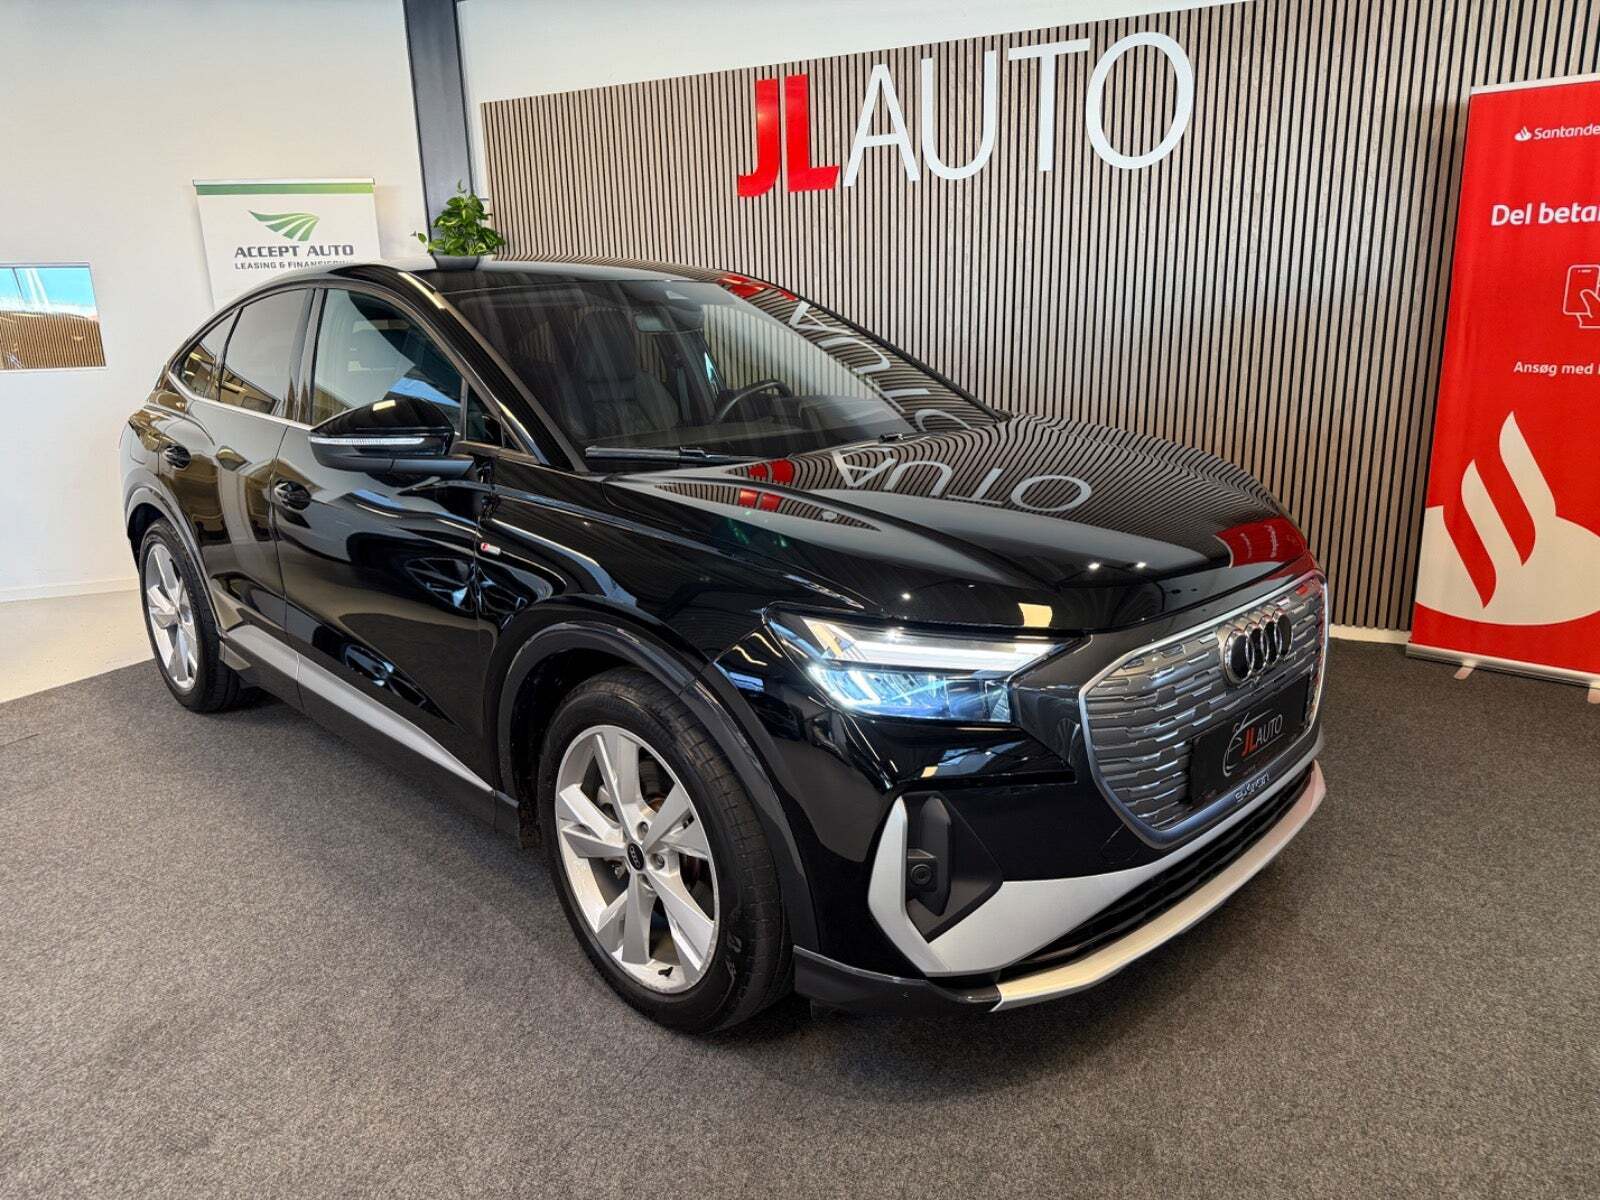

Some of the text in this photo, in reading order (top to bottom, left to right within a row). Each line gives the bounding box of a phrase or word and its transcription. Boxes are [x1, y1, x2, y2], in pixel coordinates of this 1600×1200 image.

[1491, 202, 1533, 226] Del
[234, 244, 354, 259] ACCEPT AUTO
[235, 261, 277, 270] LEASING
[279, 261, 287, 270] &
[1513, 361, 1558, 377] Ansøg
[1561, 362, 1593, 375] med
